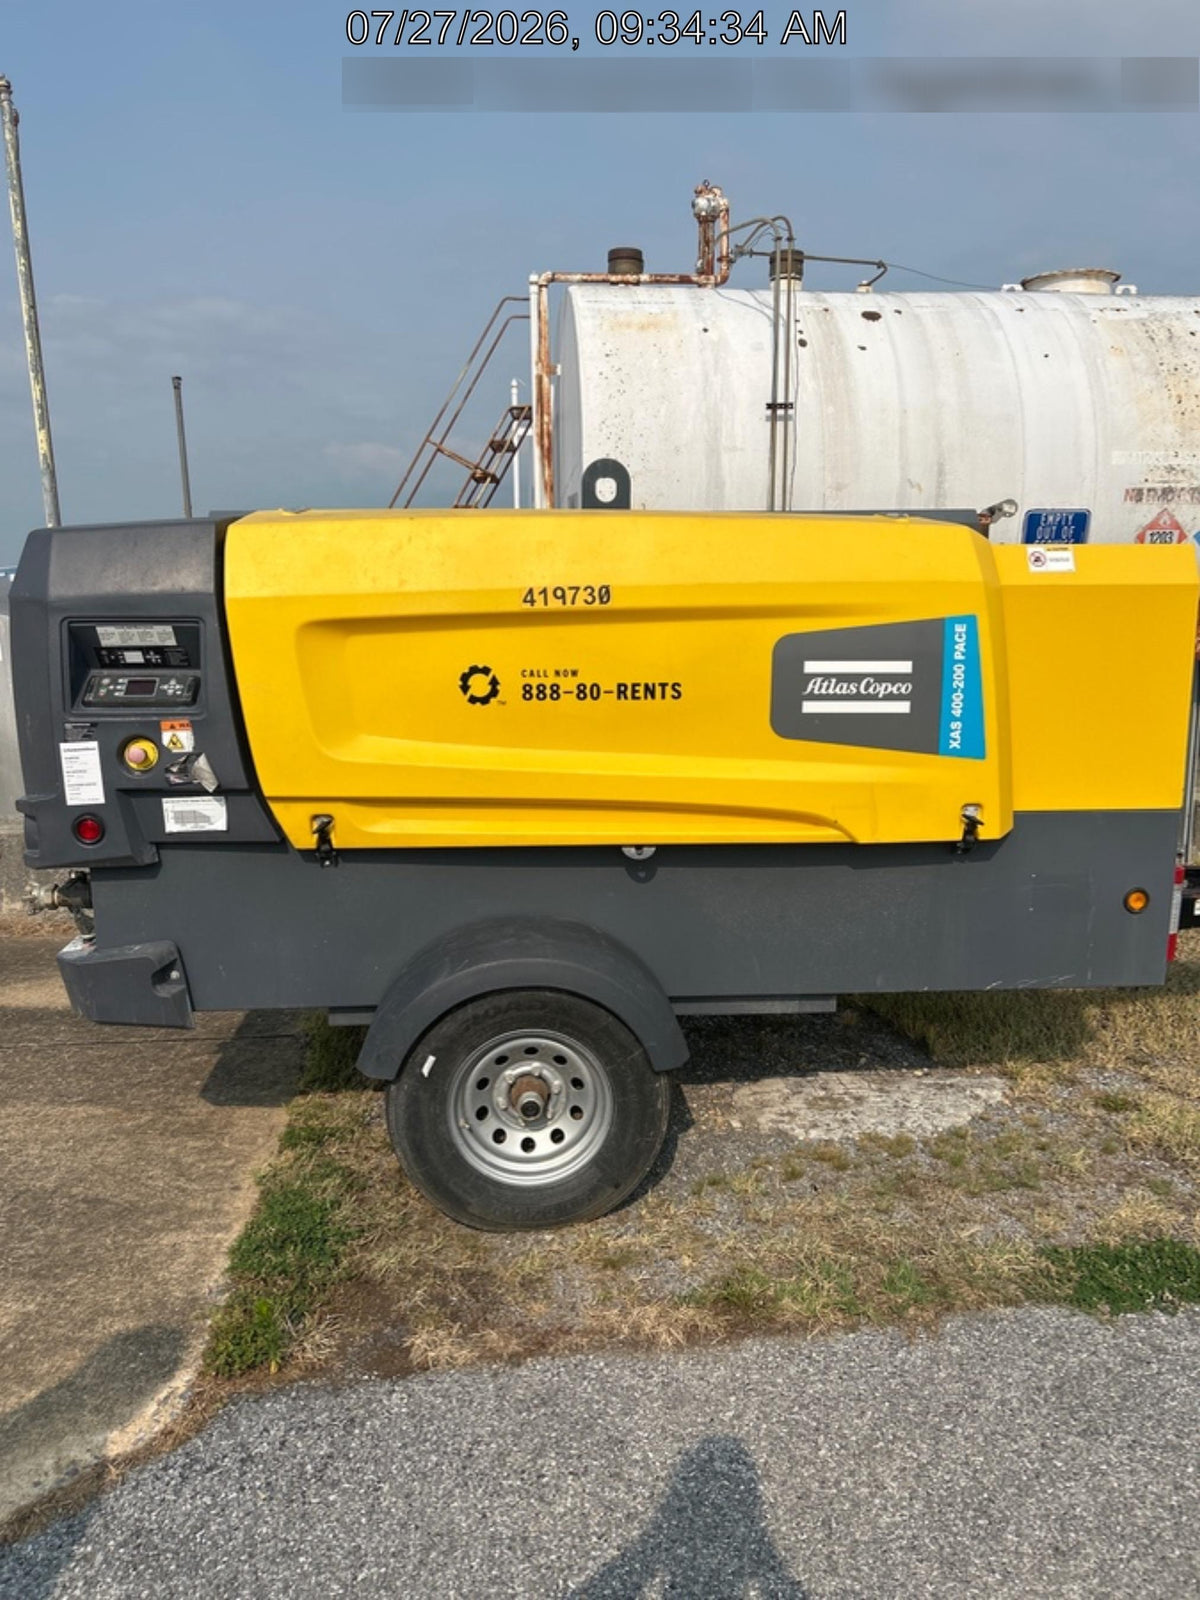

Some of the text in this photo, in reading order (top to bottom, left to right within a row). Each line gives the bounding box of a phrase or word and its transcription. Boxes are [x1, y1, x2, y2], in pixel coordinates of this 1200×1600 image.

[1040, 513, 1074, 526] EMPTY
[1036, 526, 1076, 540] OUT OF
[522, 584, 611, 607] 419730
[521, 668, 579, 678] CALL NOW
[522, 682, 683, 701] 888-80-RENTS
[802, 677, 913, 698] Atlas Copco
[949, 623, 967, 749] XAS 400-200 PACE
